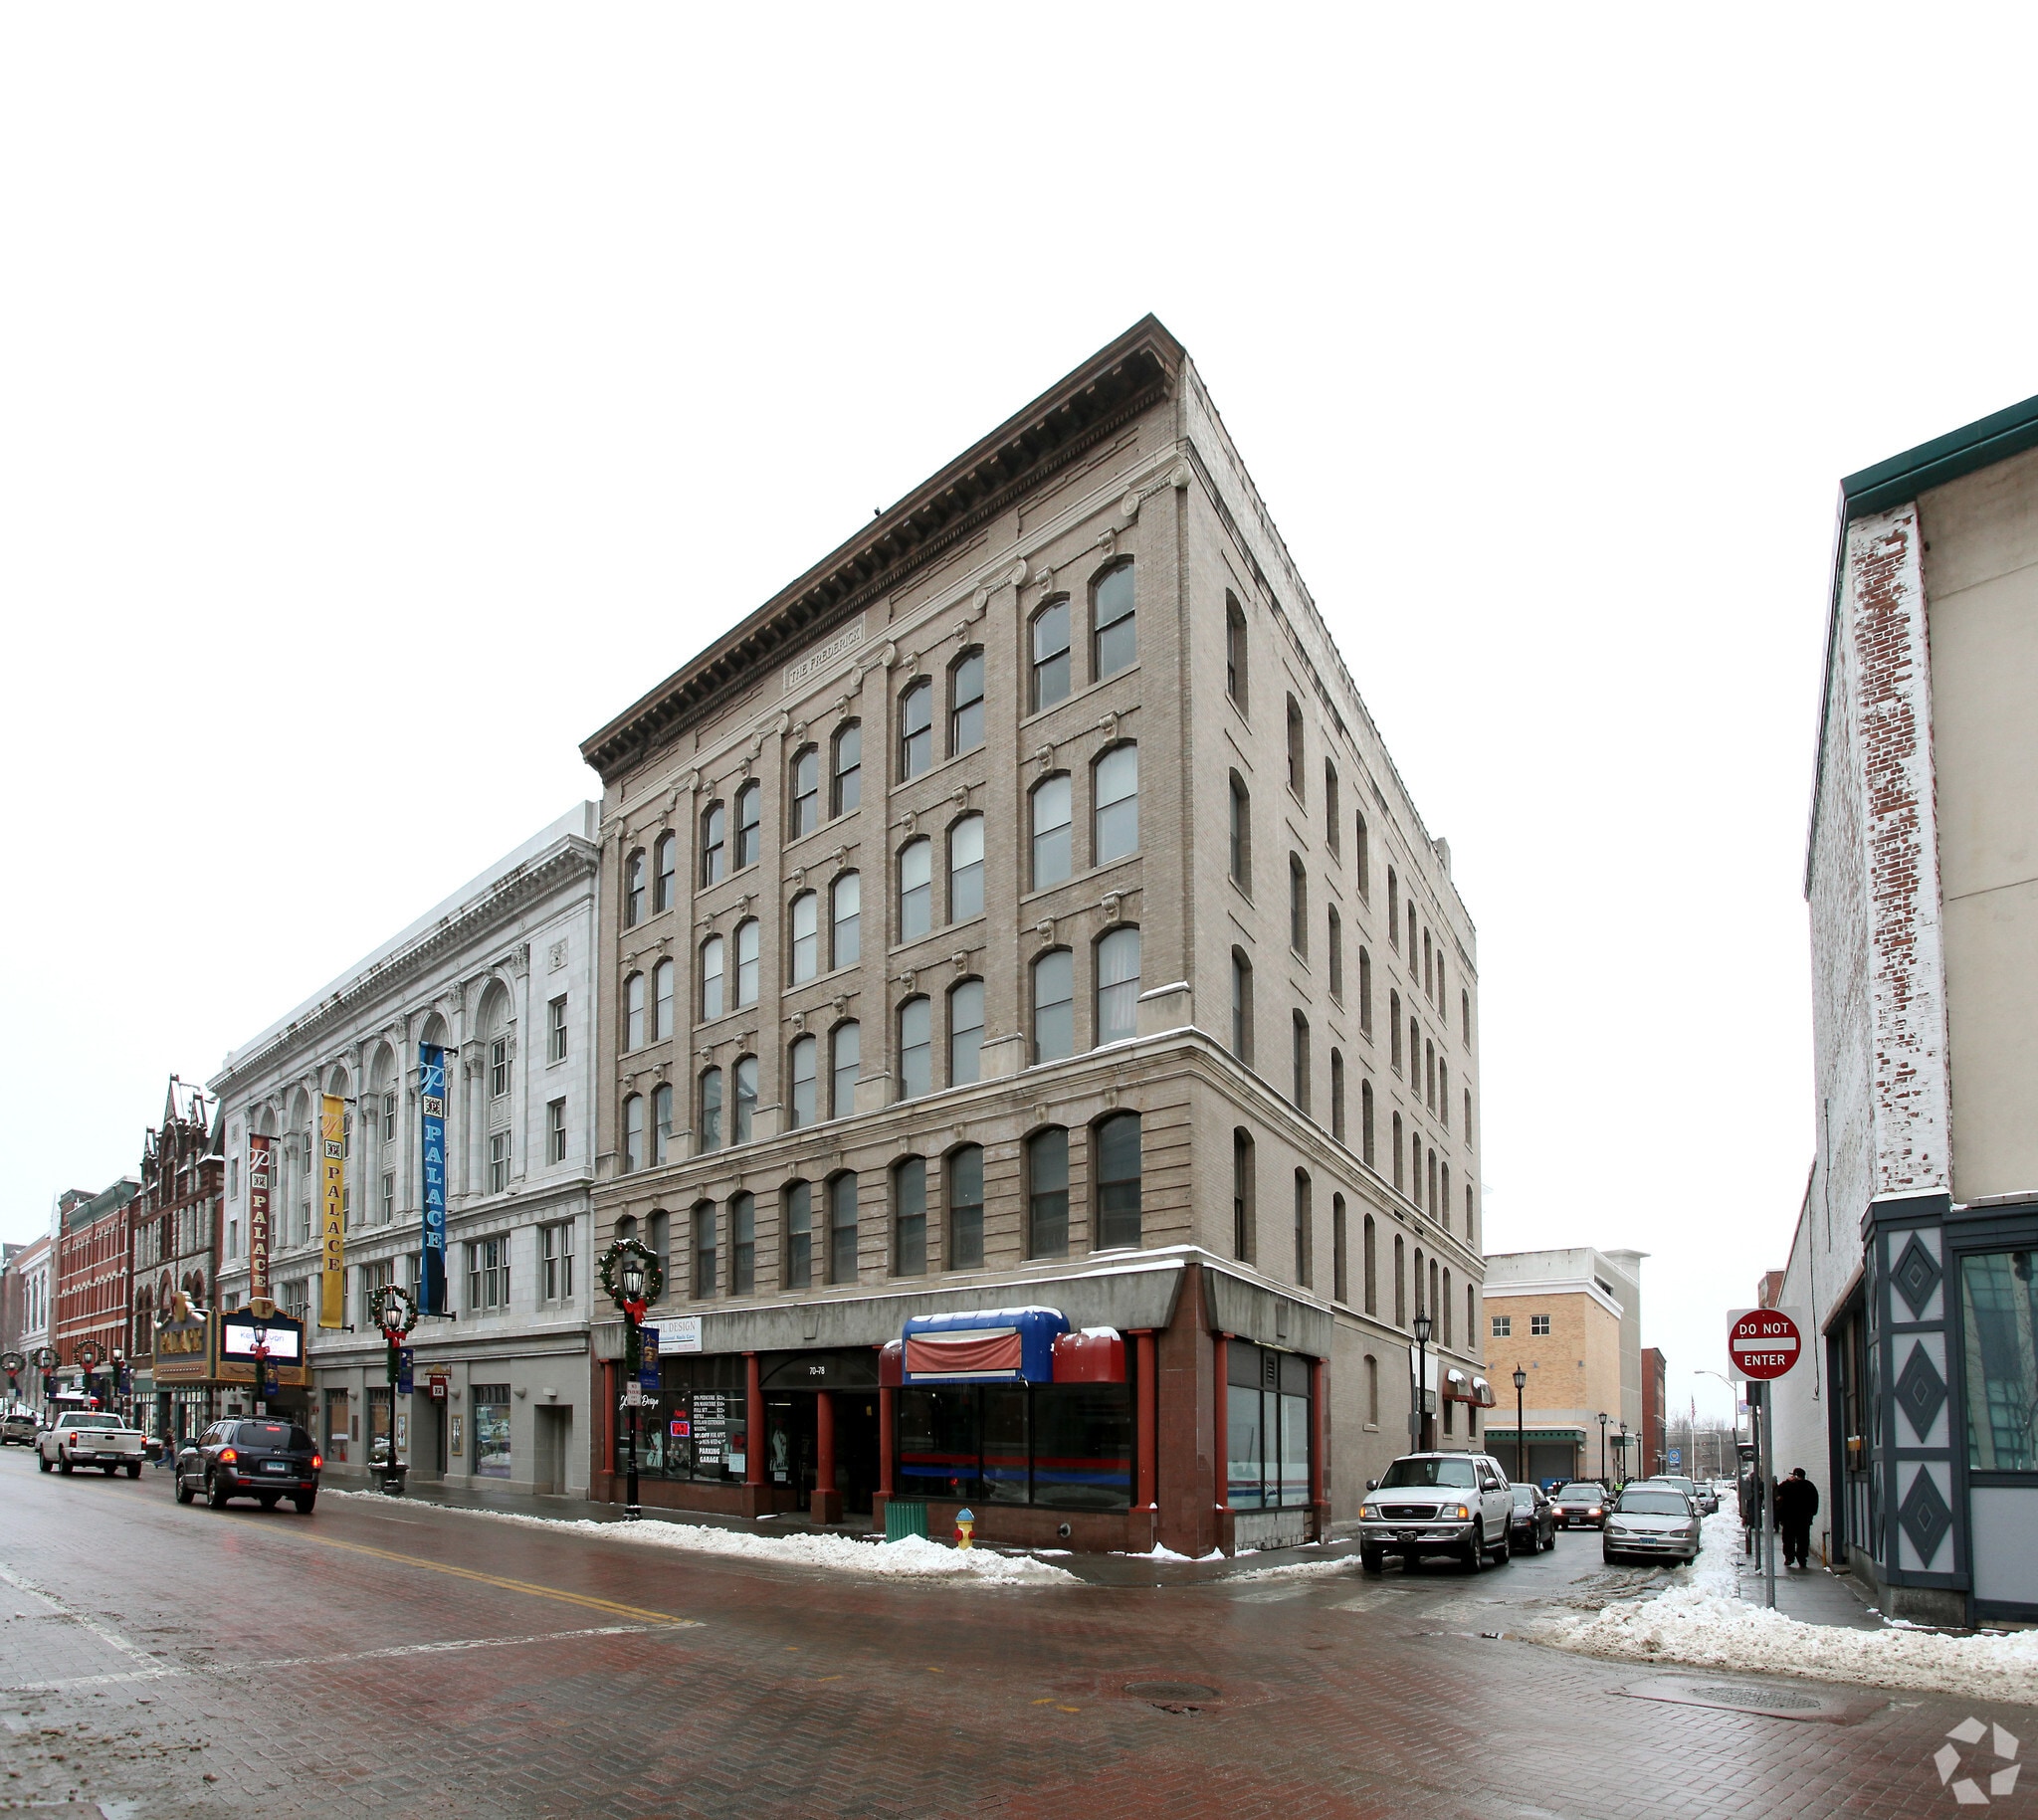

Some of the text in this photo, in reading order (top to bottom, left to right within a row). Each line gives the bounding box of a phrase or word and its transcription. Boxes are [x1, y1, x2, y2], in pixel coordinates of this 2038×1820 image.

[790, 627, 860, 683] THE FREDERICK
[425, 1125, 443, 1248] PALACE
[327, 1167, 340, 1272] PALACE
[252, 1195, 267, 1288] PALACE
[261, 1301, 272, 1314] P
[669, 1321, 696, 1332] DESIGN
[1739, 1322, 1789, 1334] DO NOT
[1744, 1354, 1785, 1365] ENTER
